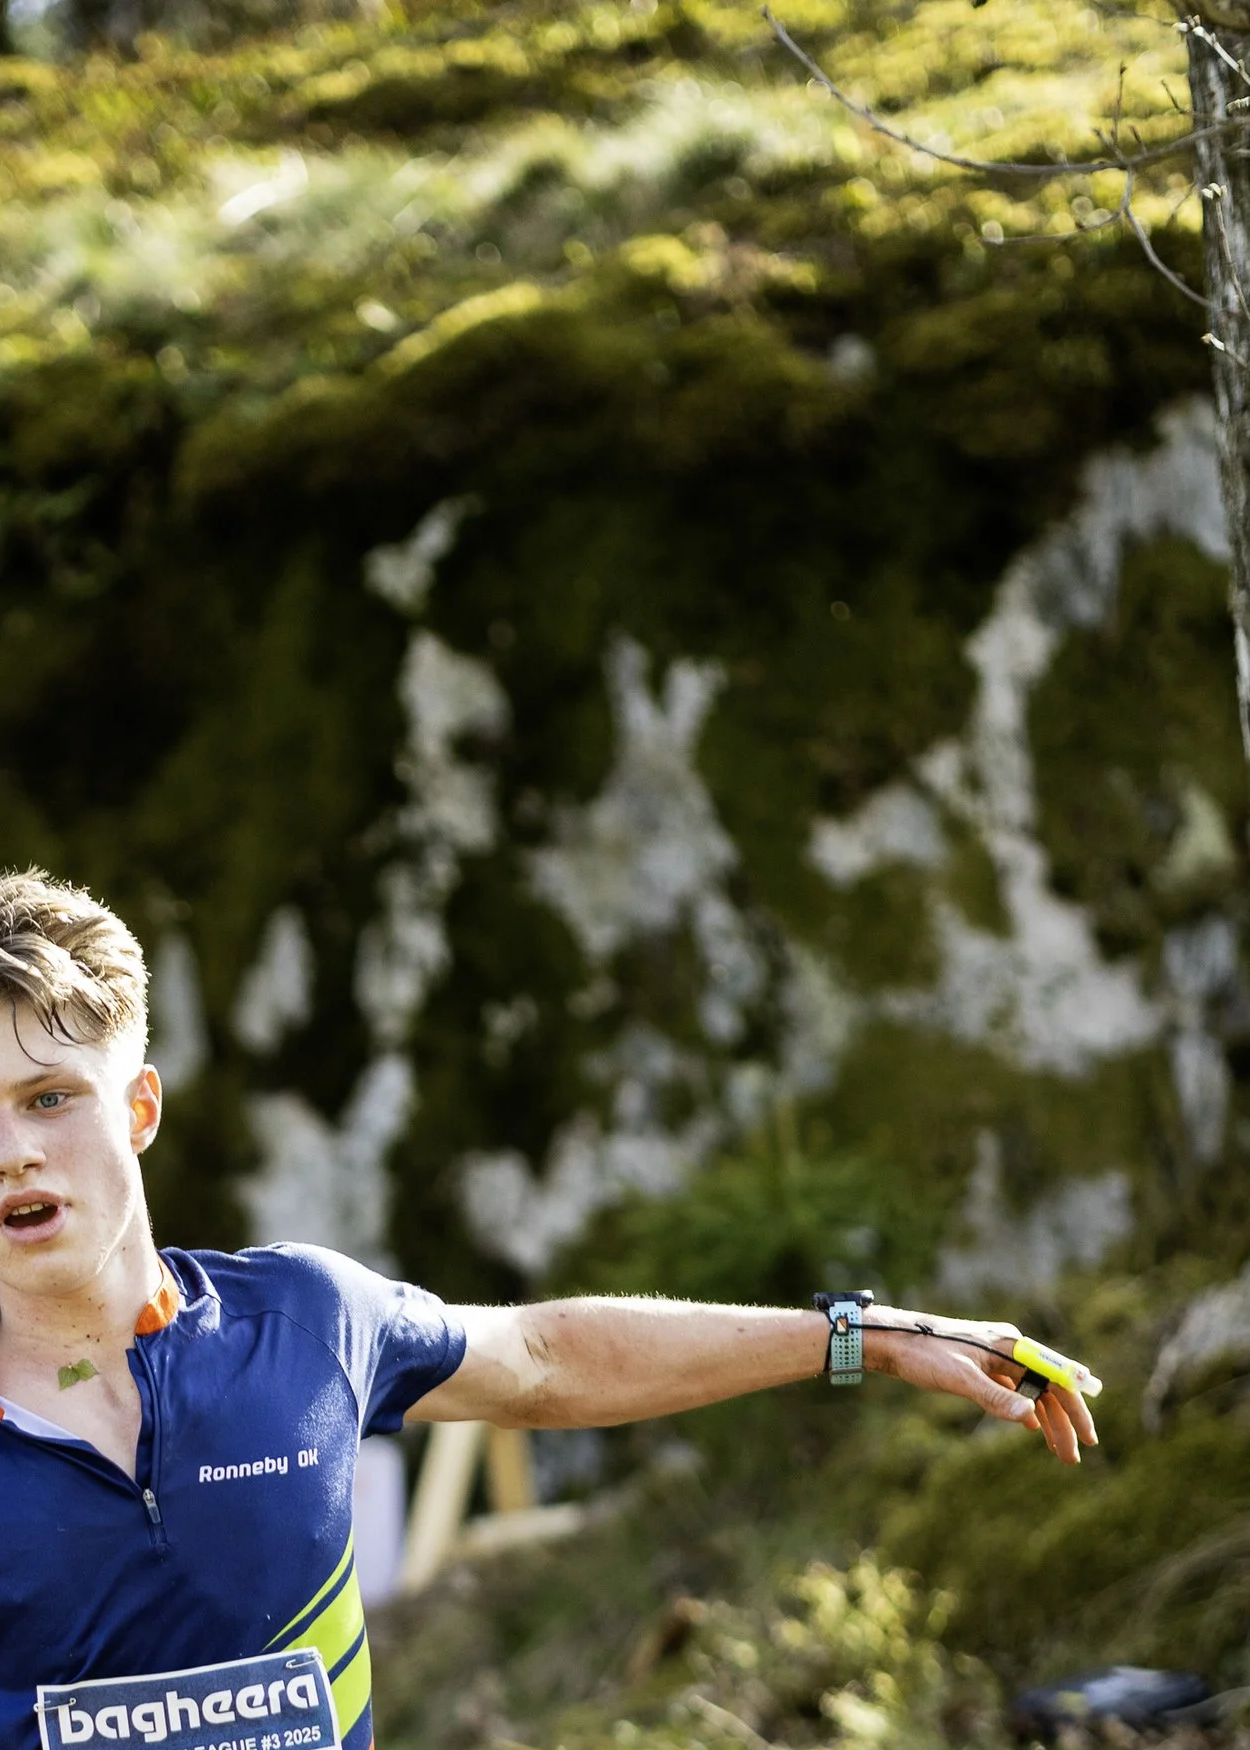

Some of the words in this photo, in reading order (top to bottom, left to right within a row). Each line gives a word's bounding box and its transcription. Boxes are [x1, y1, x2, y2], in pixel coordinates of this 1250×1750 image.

[199, 1456, 288, 1483] Ronneby
[298, 1448, 319, 1468] OK
[58, 1673, 320, 1744] bagheera
[261, 1736, 281, 1750] #3
[284, 1725, 322, 1747] 2025
